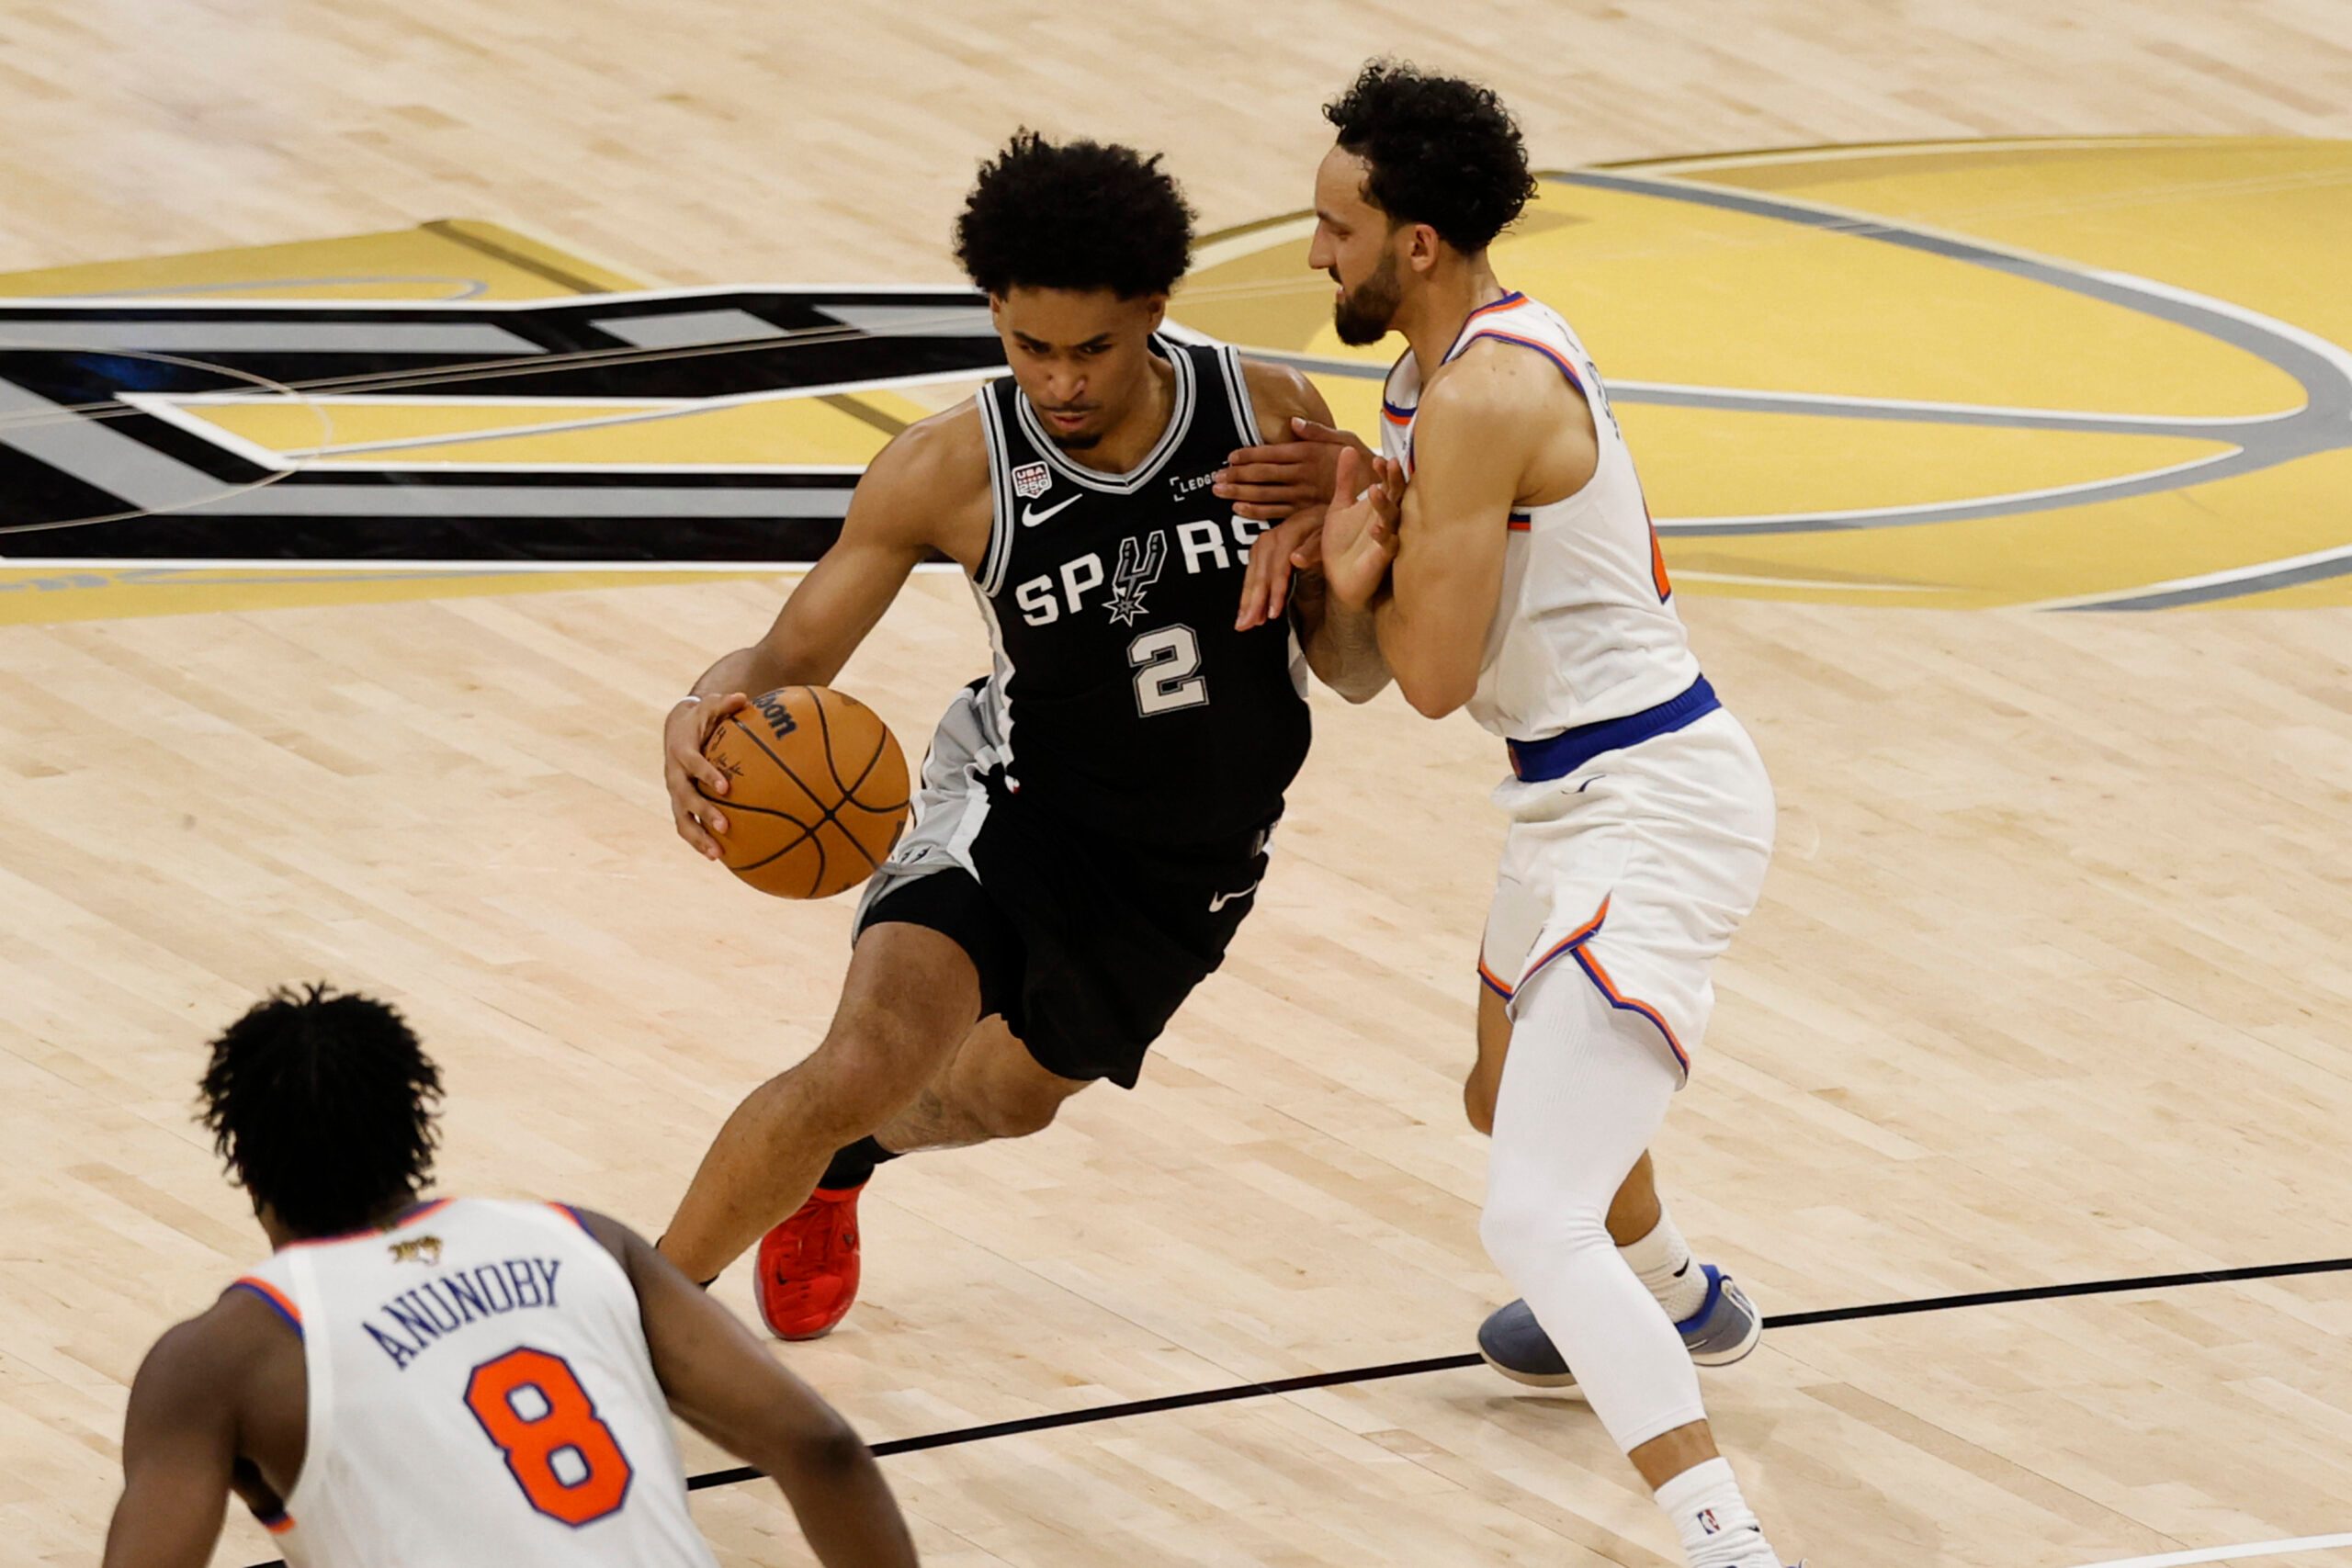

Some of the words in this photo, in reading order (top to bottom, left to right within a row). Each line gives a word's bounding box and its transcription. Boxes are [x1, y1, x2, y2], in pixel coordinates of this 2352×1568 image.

[1016, 467, 1045, 479] USA
[1019, 479, 1048, 493] 250
[1126, 623, 1211, 718] 2
[361, 1256, 561, 1371] ANUNOBY
[463, 1345, 634, 1529] 8
